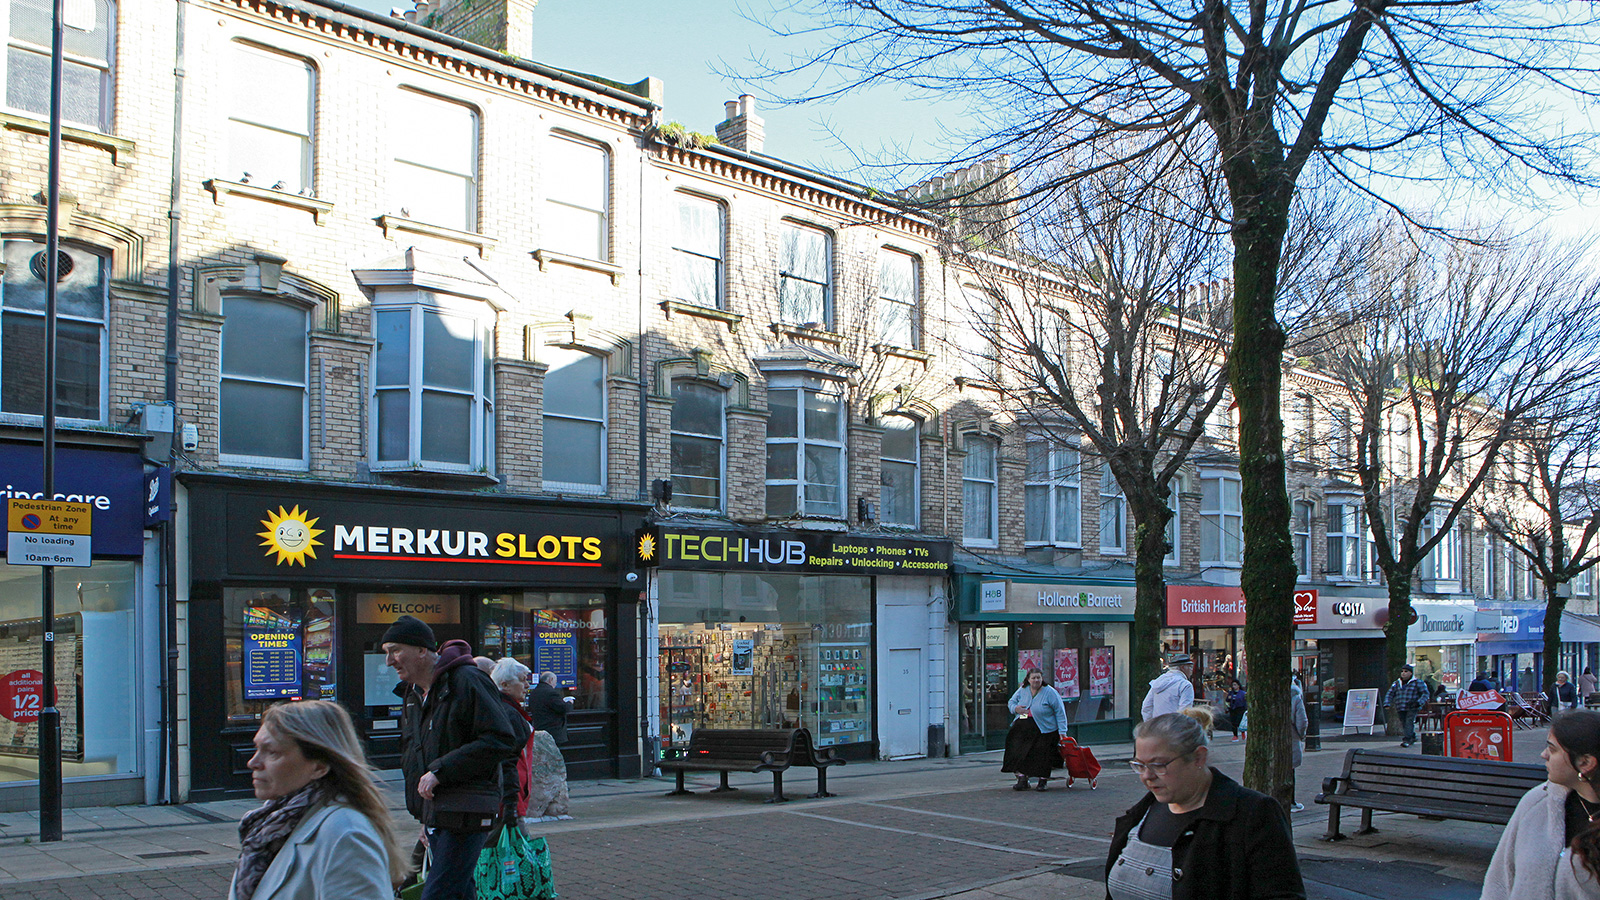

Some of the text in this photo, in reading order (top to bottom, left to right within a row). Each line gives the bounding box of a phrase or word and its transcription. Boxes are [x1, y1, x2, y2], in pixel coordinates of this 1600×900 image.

[13, 501, 87, 513] Pedestrian Zone
[63, 516, 79, 524] any
[41, 537, 75, 546] loading
[333, 524, 602, 561] MERKUR SLOTS
[832, 543, 929, 557] Laptops Phones TVs
[25, 554, 74, 563] 10am-6pm
[809, 555, 949, 570] Repairs Unlocking Accessories
[378, 604, 442, 614] WELCOME
[1181, 598, 1211, 613] British
[1213, 599, 1236, 613] Heart
[1339, 602, 1366, 616] COSTA
[1420, 614, 1464, 632] Bonmarché
[12, 694, 40, 709] 1/2
[1459, 691, 1497, 706] BIG SALE
[13, 709, 40, 718] price
